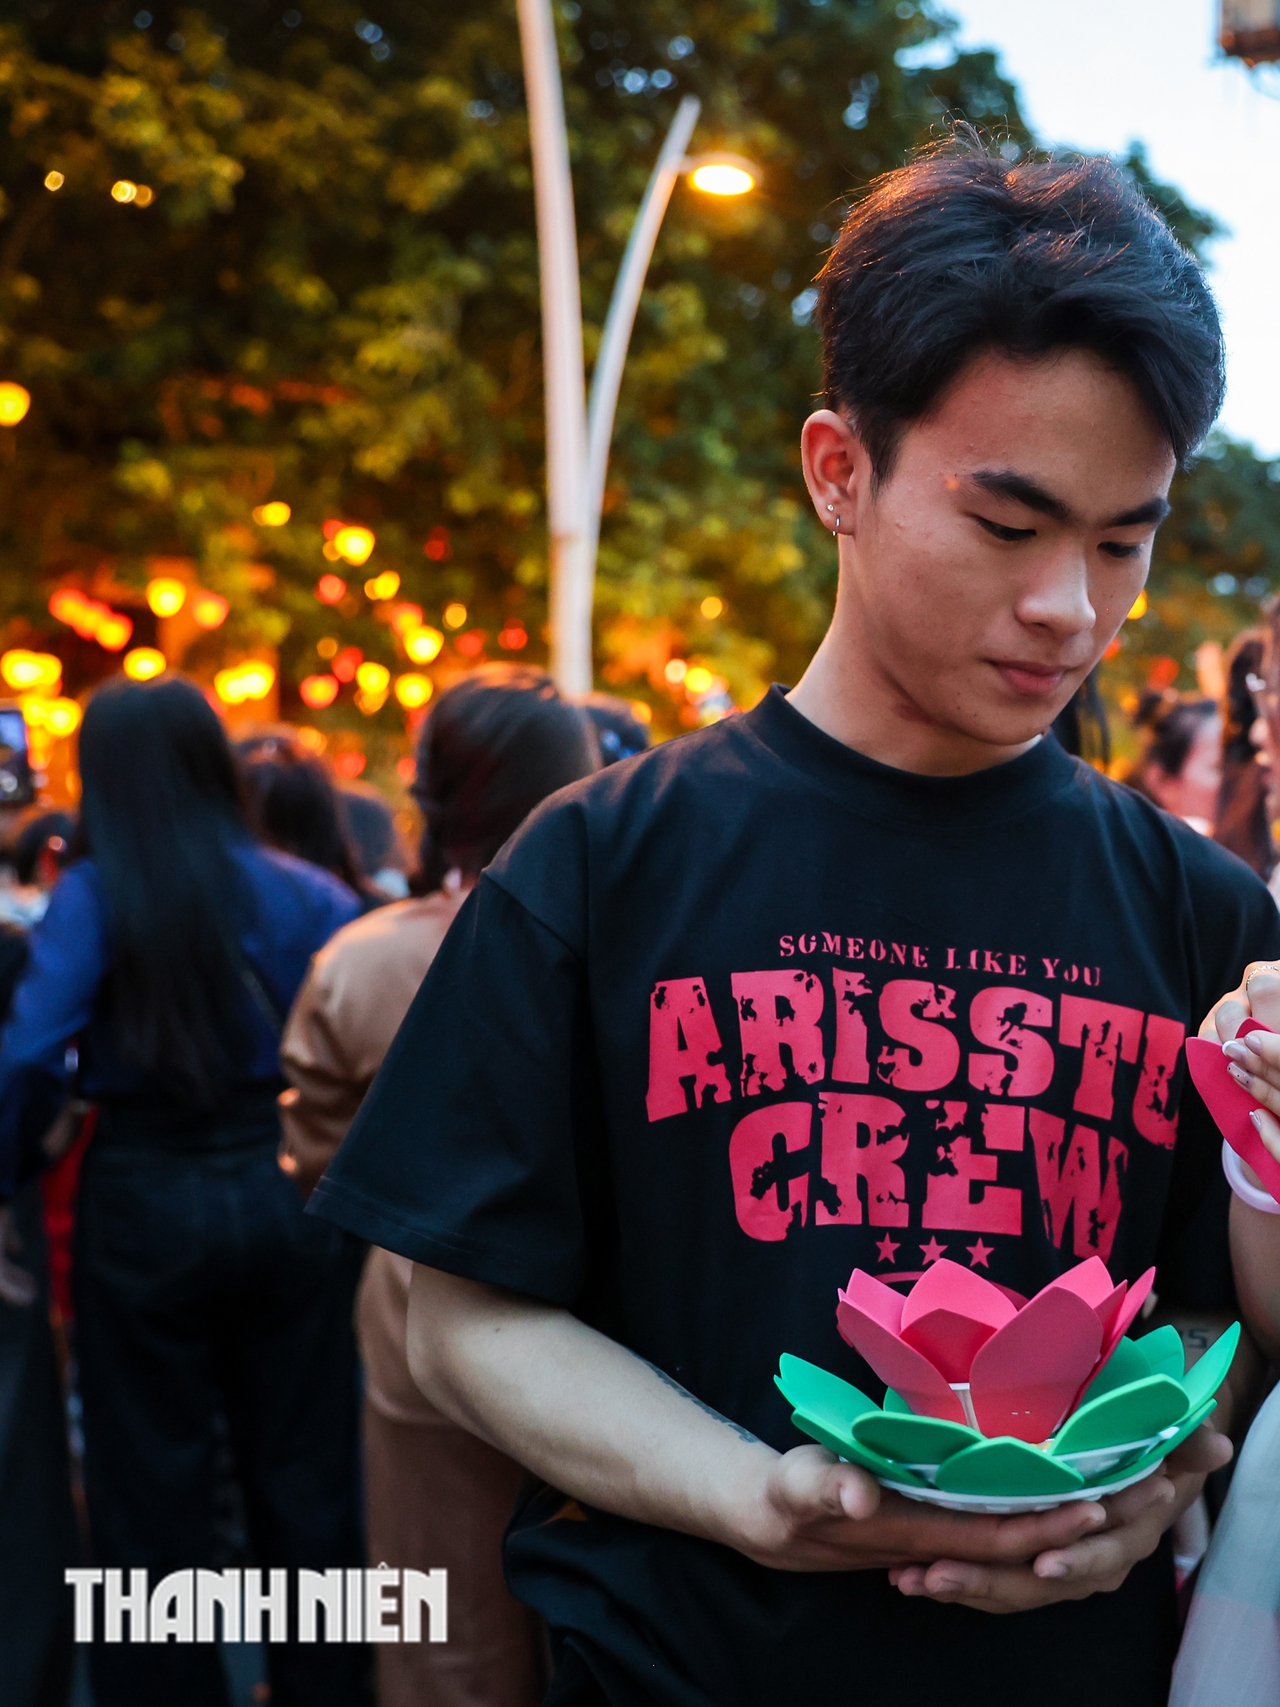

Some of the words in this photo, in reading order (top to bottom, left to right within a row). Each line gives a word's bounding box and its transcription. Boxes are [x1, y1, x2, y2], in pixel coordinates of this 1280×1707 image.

[779, 931, 930, 969] SOMEONE
[945, 948, 1027, 976] LIKE
[1041, 957, 1101, 987] YOU
[728, 1091, 1129, 1265] CREW
